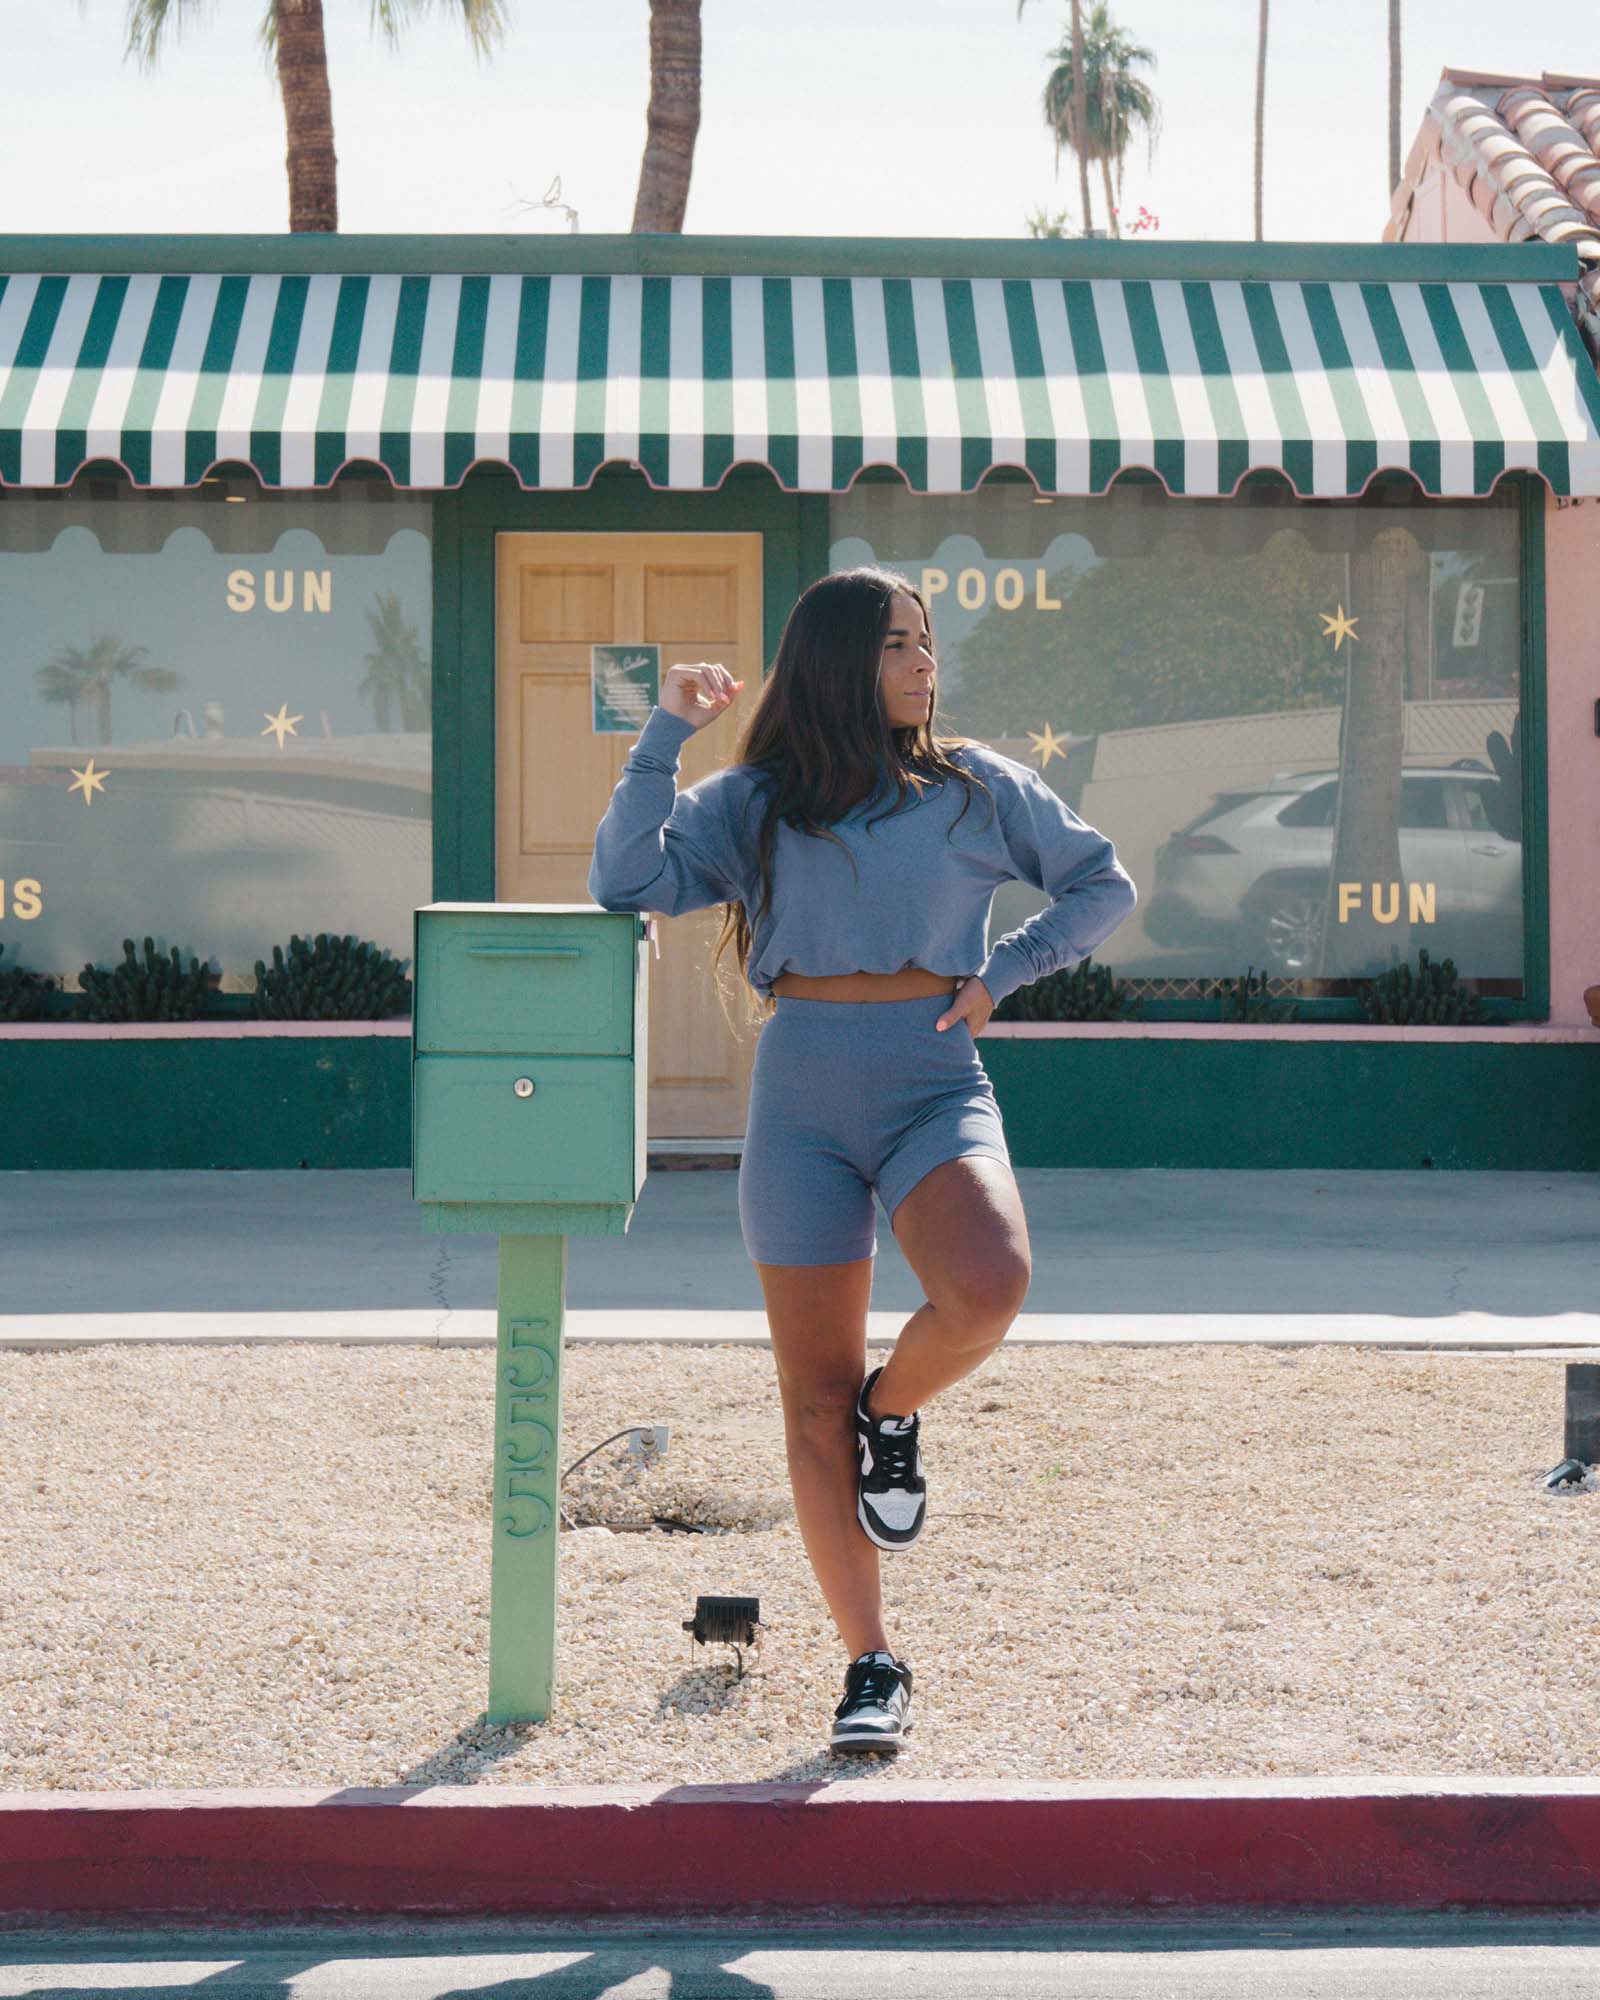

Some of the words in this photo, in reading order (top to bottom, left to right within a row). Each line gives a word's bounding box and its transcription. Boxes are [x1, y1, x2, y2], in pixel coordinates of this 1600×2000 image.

[226, 569, 332, 612] SUN
[921, 567, 1062, 610] POOL
[1338, 882, 1436, 924] FUN
[503, 1319, 555, 1541] 555
